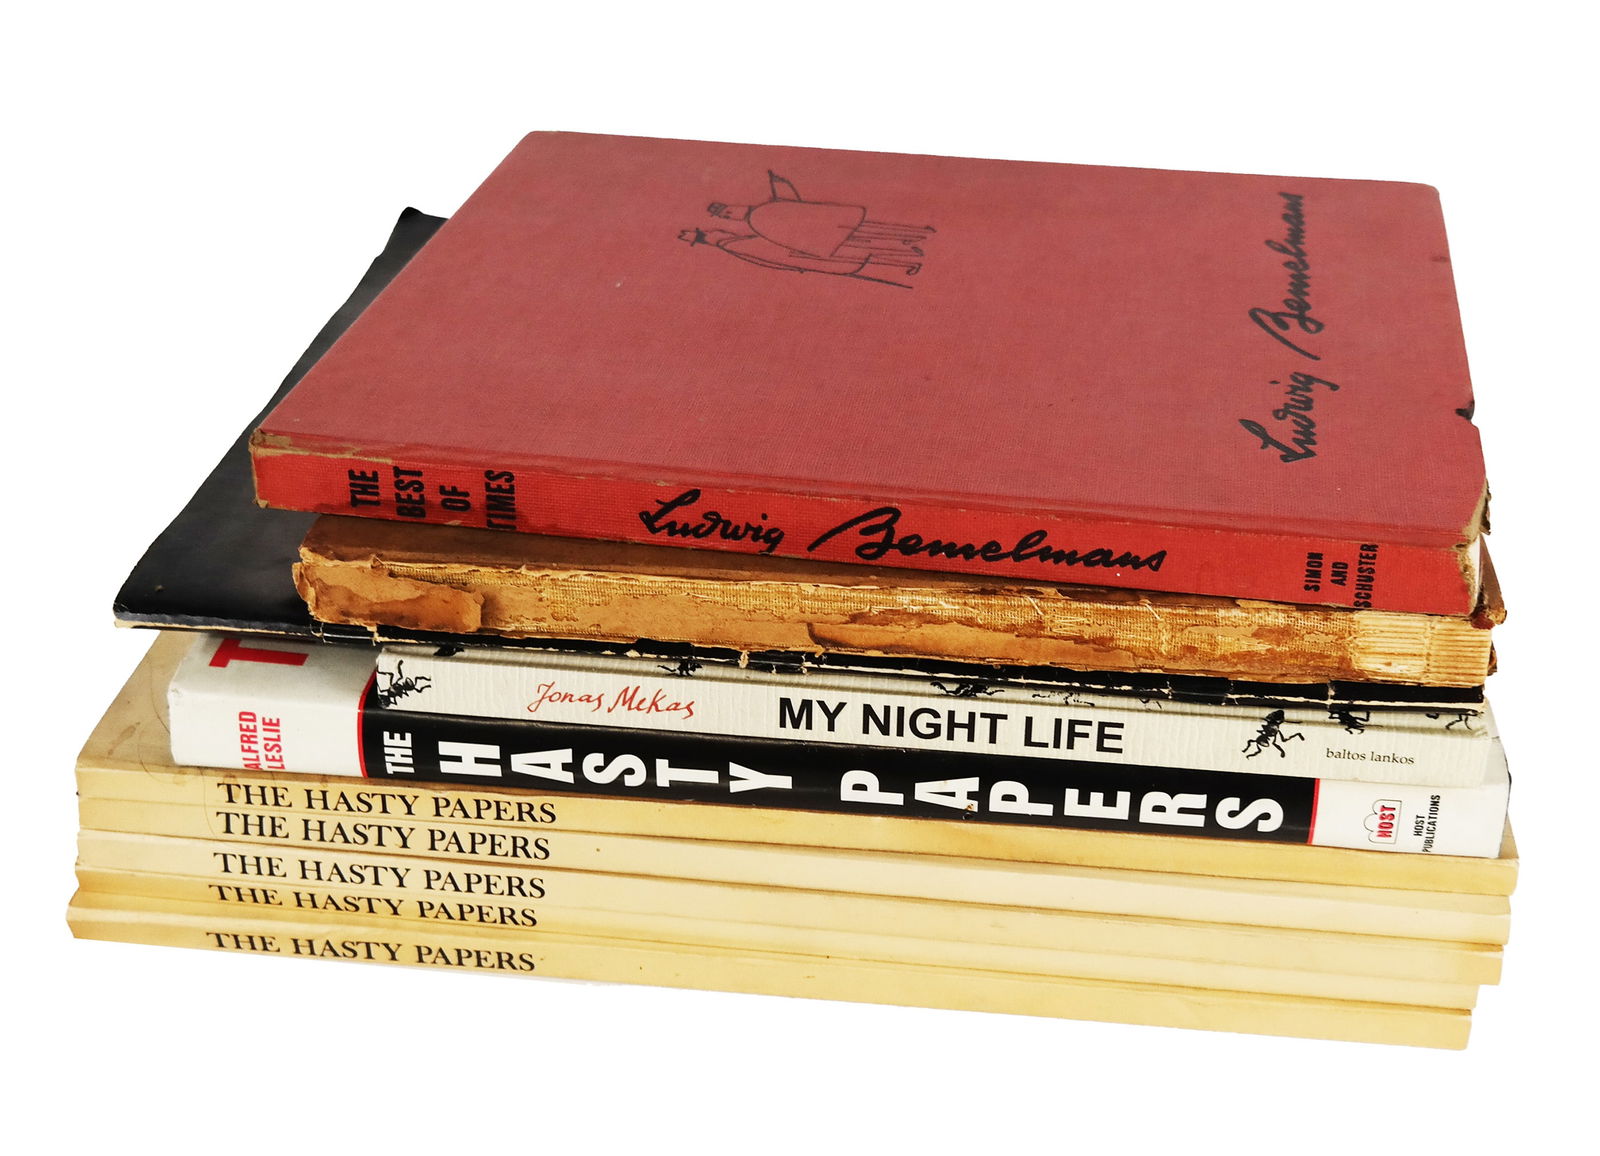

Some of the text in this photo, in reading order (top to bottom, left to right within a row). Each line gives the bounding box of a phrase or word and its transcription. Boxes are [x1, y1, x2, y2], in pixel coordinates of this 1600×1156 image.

[1238, 371, 1340, 464] Ludwig
[348, 468, 380, 508] THE
[393, 465, 426, 520] BEST
[439, 485, 472, 513] OF
[484, 470, 516, 531] TIMES
[639, 488, 1168, 572] Ludwig Bemelmans
[1304, 552, 1324, 592] SIMON
[1330, 561, 1348, 587] AND
[1353, 543, 1379, 609] SCHUSTER
[527, 682, 604, 714] Jonas
[239, 710, 259, 771] ALFRED
[261, 716, 286, 771] LESLIE
[778, 697, 1126, 755] MY NIGHT LIFE
[1325, 747, 1415, 765] baltos lankos
[217, 782, 556, 823] THE HASTY PAPERS
[383, 731, 1284, 833] THE HASTY PAPERS
[216, 811, 550, 860] THE HASTY PAPERS
[1376, 803, 1397, 839] HOST
[1413, 814, 1426, 837] HOST
[1422, 794, 1441, 853] PUBLICATIONS
[213, 852, 545, 898] THE HASTY PAPERS
[208, 884, 537, 927] THE HASTY PAPERS
[206, 932, 535, 971] THE HASTY PAPERS
